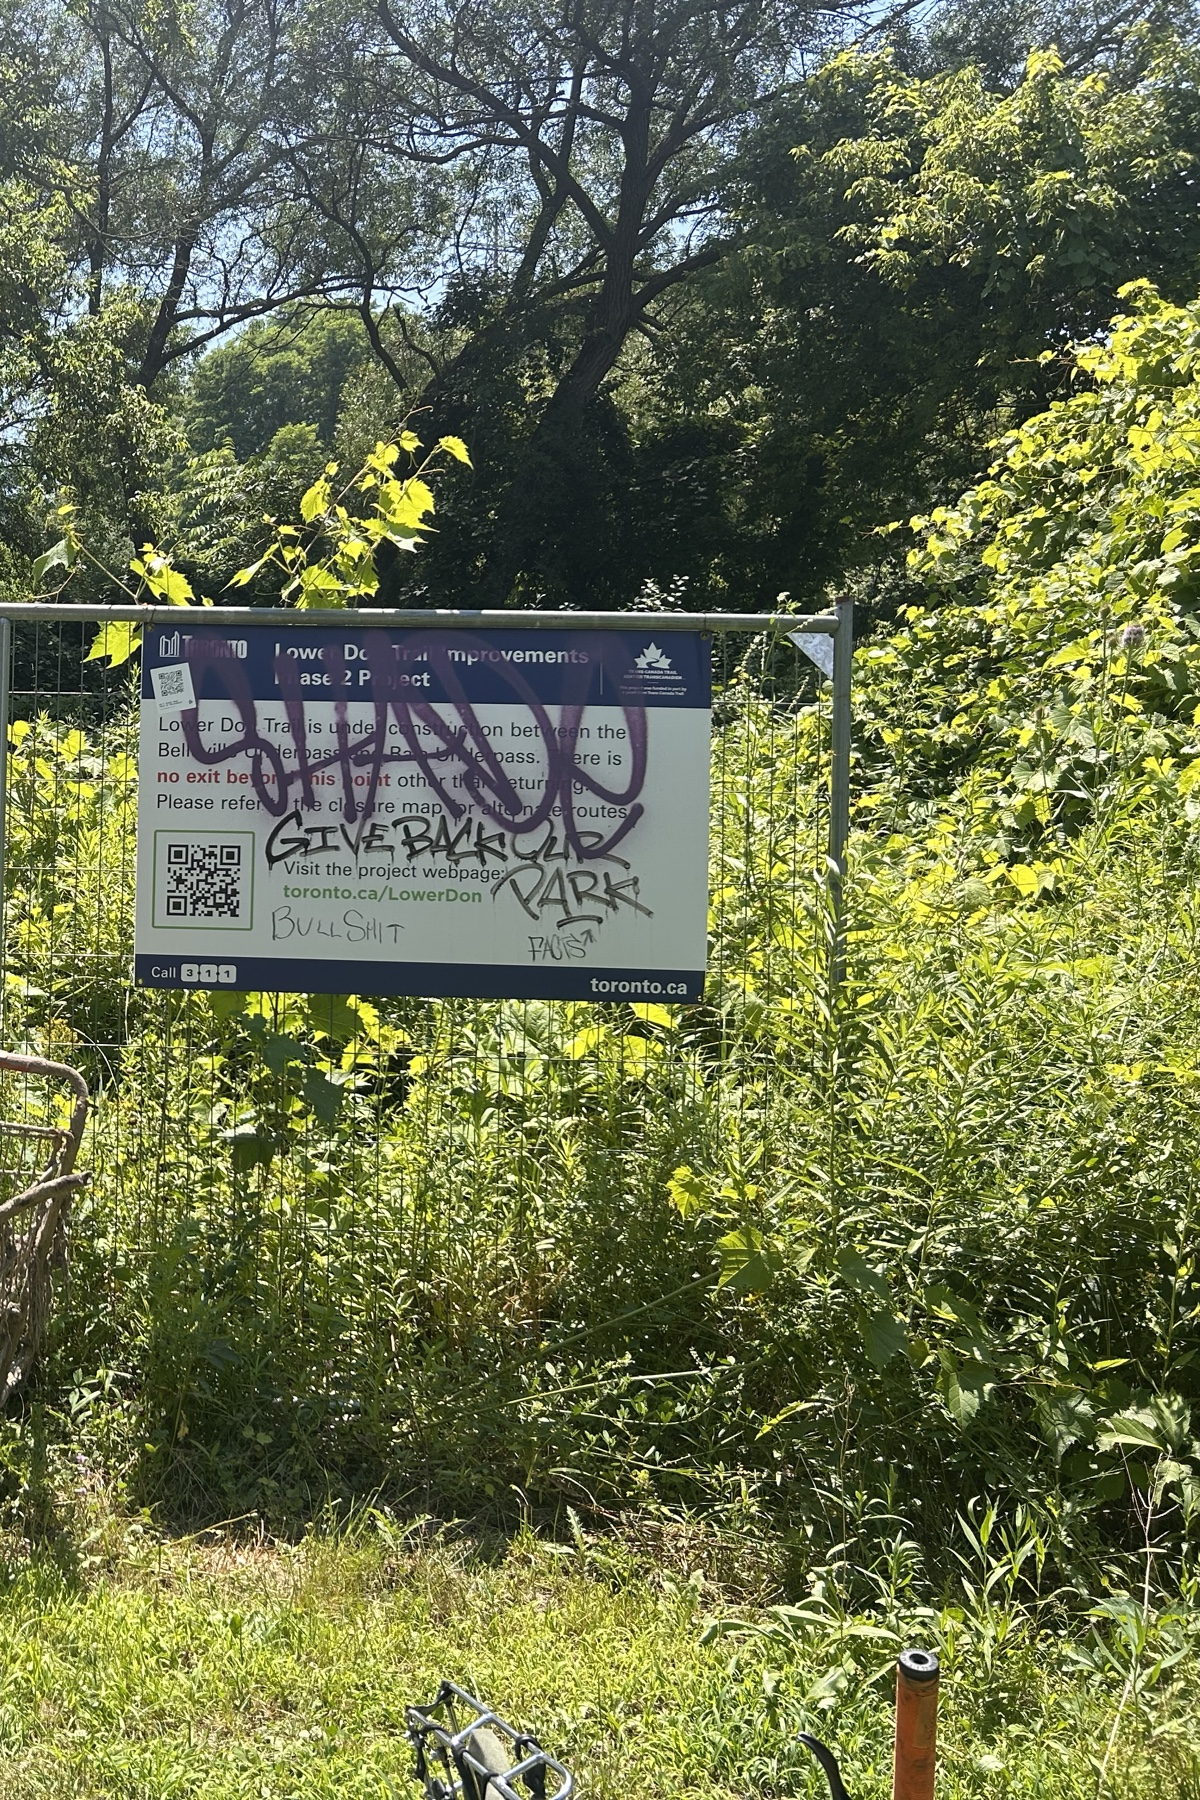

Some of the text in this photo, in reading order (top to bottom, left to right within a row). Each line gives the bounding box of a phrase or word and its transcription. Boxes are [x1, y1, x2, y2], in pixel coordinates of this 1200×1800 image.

[443, 648, 590, 665] mprovements
[341, 671, 352, 686] 2
[221, 717, 255, 733] Do
[263, 717, 299, 733] Tra
[308, 719, 322, 734] is
[329, 719, 380, 735] unde
[597, 724, 626, 739] the
[608, 750, 622, 765] is
[157, 771, 179, 785] no
[186, 769, 220, 784] exit
[299, 770, 335, 786] his
[398, 773, 446, 788] othr
[157, 794, 214, 811] Please
[402, 801, 442, 817] map
[452, 799, 475, 816] or
[265, 810, 395, 866] GIVE
[392, 815, 509, 866] BACK
[283, 861, 506, 882] Visit the project webpage:
[283, 885, 482, 903] toronto.ca/LowerDon
[491, 862, 654, 920] PARK
[151, 966, 176, 979] Call
[590, 977, 688, 995] toronto.ca
